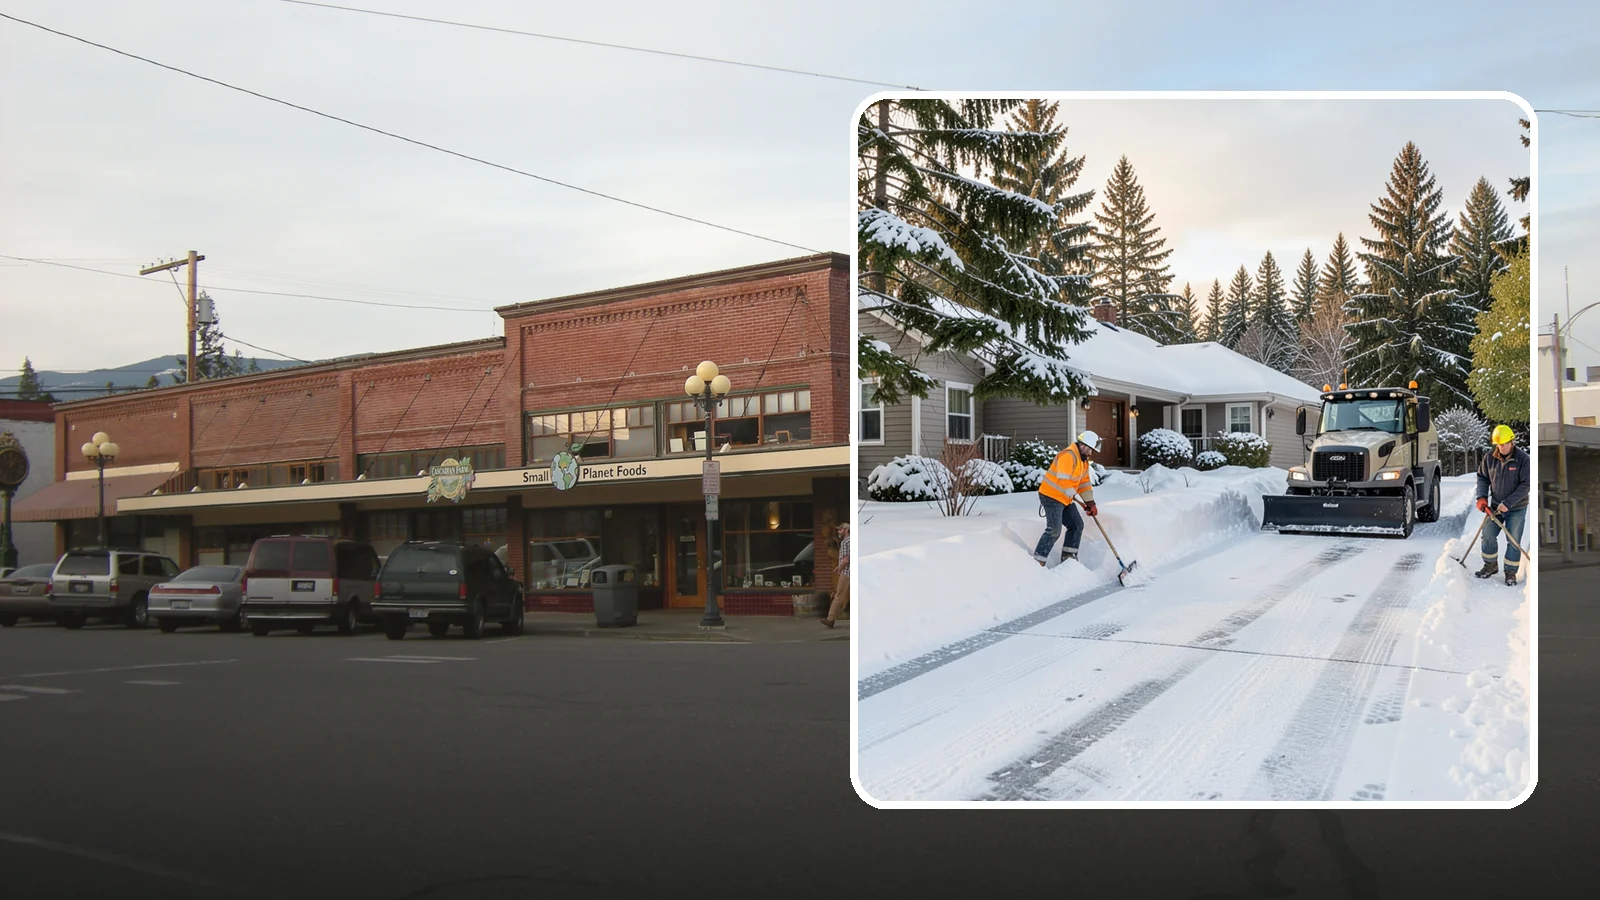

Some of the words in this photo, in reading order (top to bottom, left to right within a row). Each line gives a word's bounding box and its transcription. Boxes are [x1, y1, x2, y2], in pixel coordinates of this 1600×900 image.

[523, 471, 548, 483] Small
[583, 467, 614, 479] Planet
[617, 464, 647, 477] Foods
